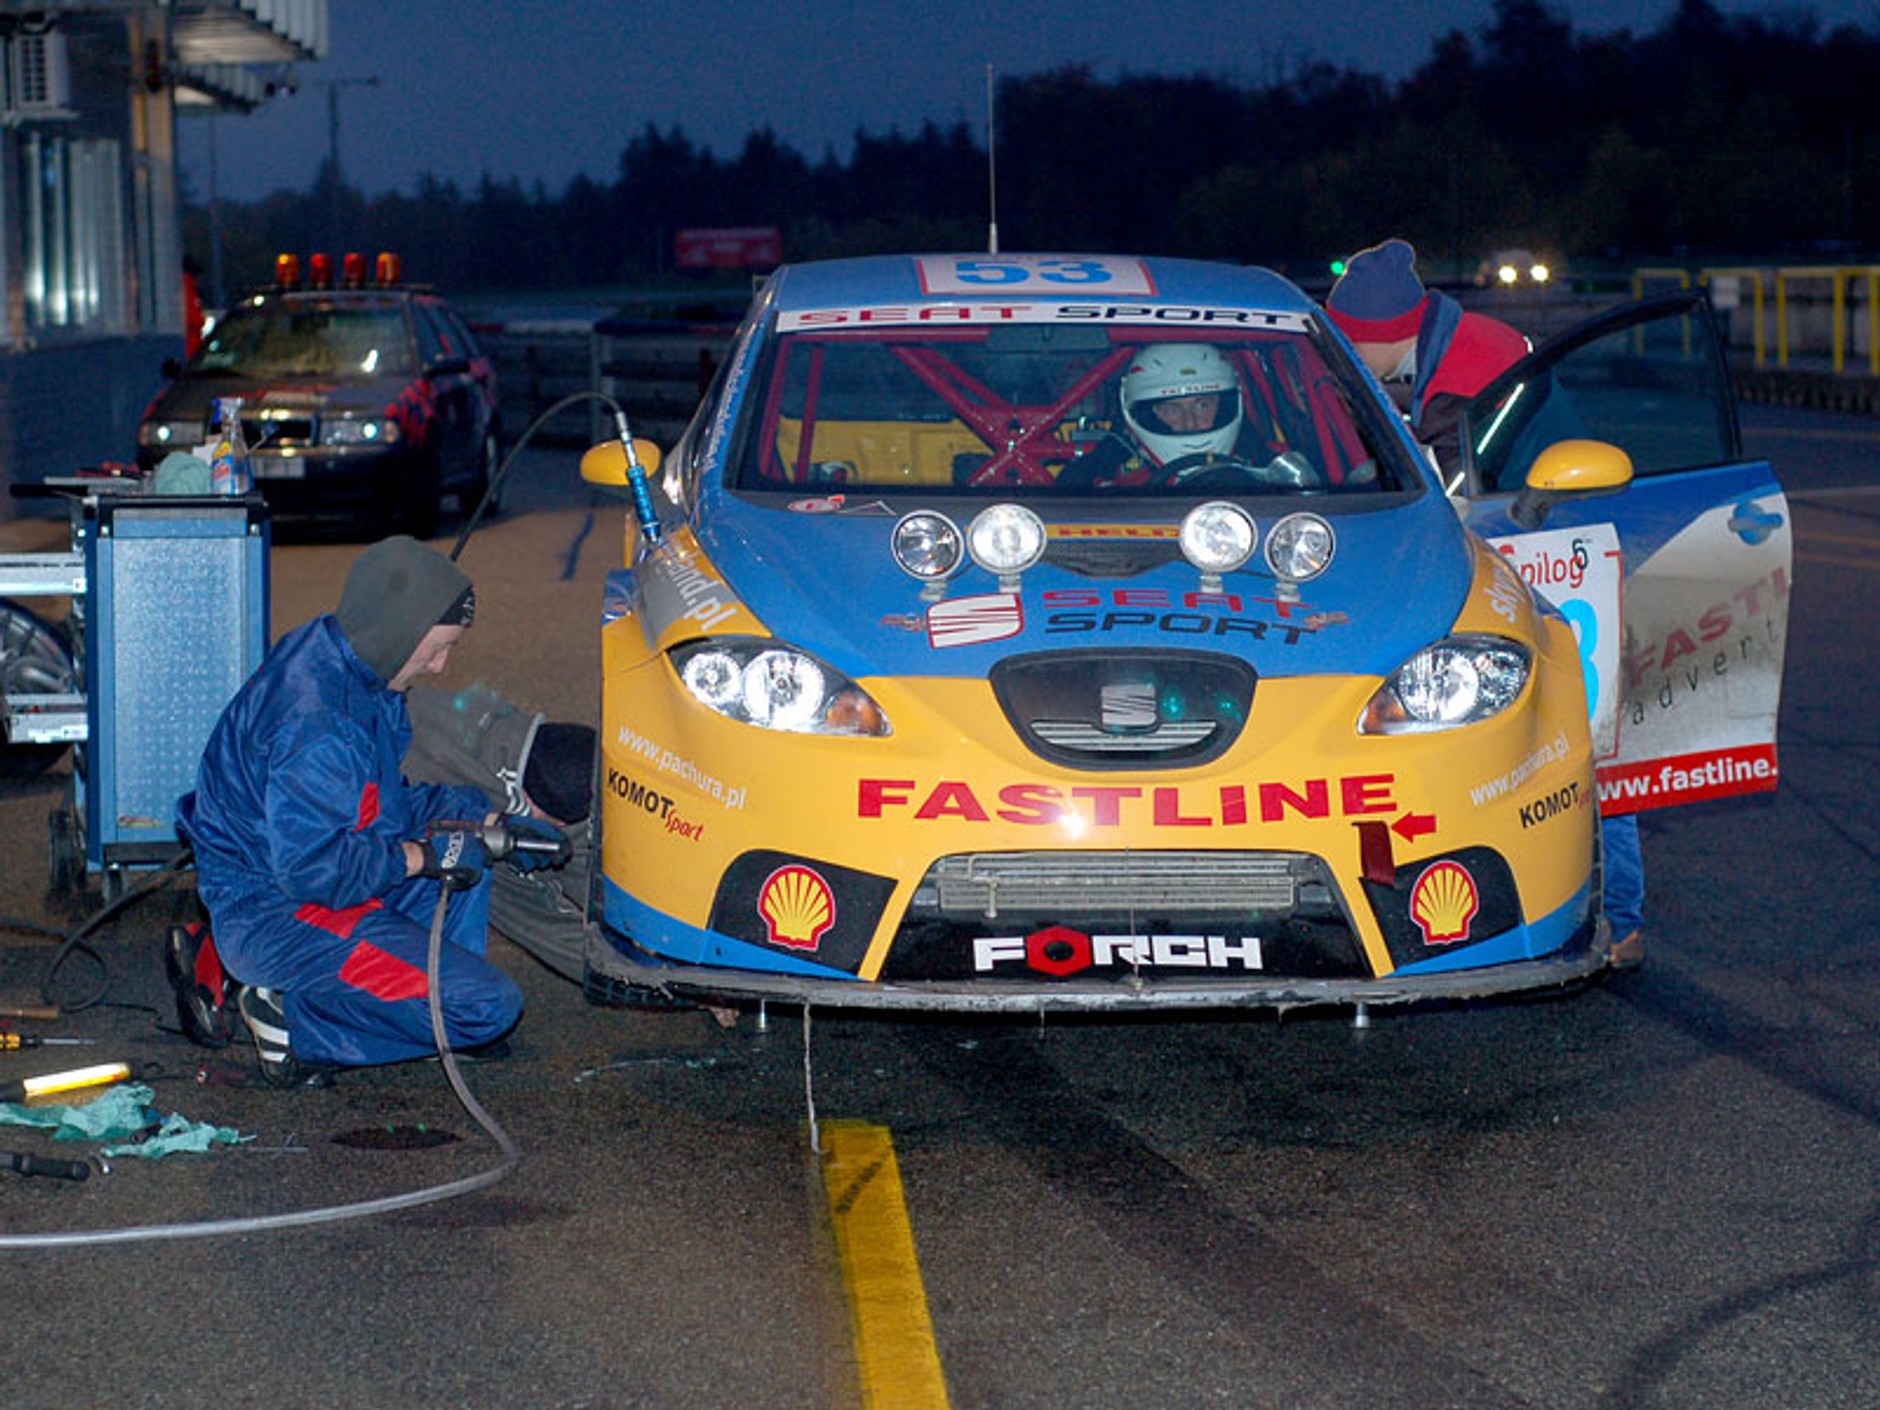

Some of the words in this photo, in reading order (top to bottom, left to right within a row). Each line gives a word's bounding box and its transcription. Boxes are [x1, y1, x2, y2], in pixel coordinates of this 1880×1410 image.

[955, 260, 1113, 284] 53
[800, 306, 1032, 323] SEAT
[1056, 305, 1291, 325] SPORT
[1043, 590, 1311, 619] SEAT
[1044, 612, 1318, 646] SPORT
[618, 726, 747, 810] www.pachura.pl
[608, 767, 674, 819] KOMOT
[858, 773, 1397, 826] FASTLINE
[1518, 782, 1578, 838] KOMOT
